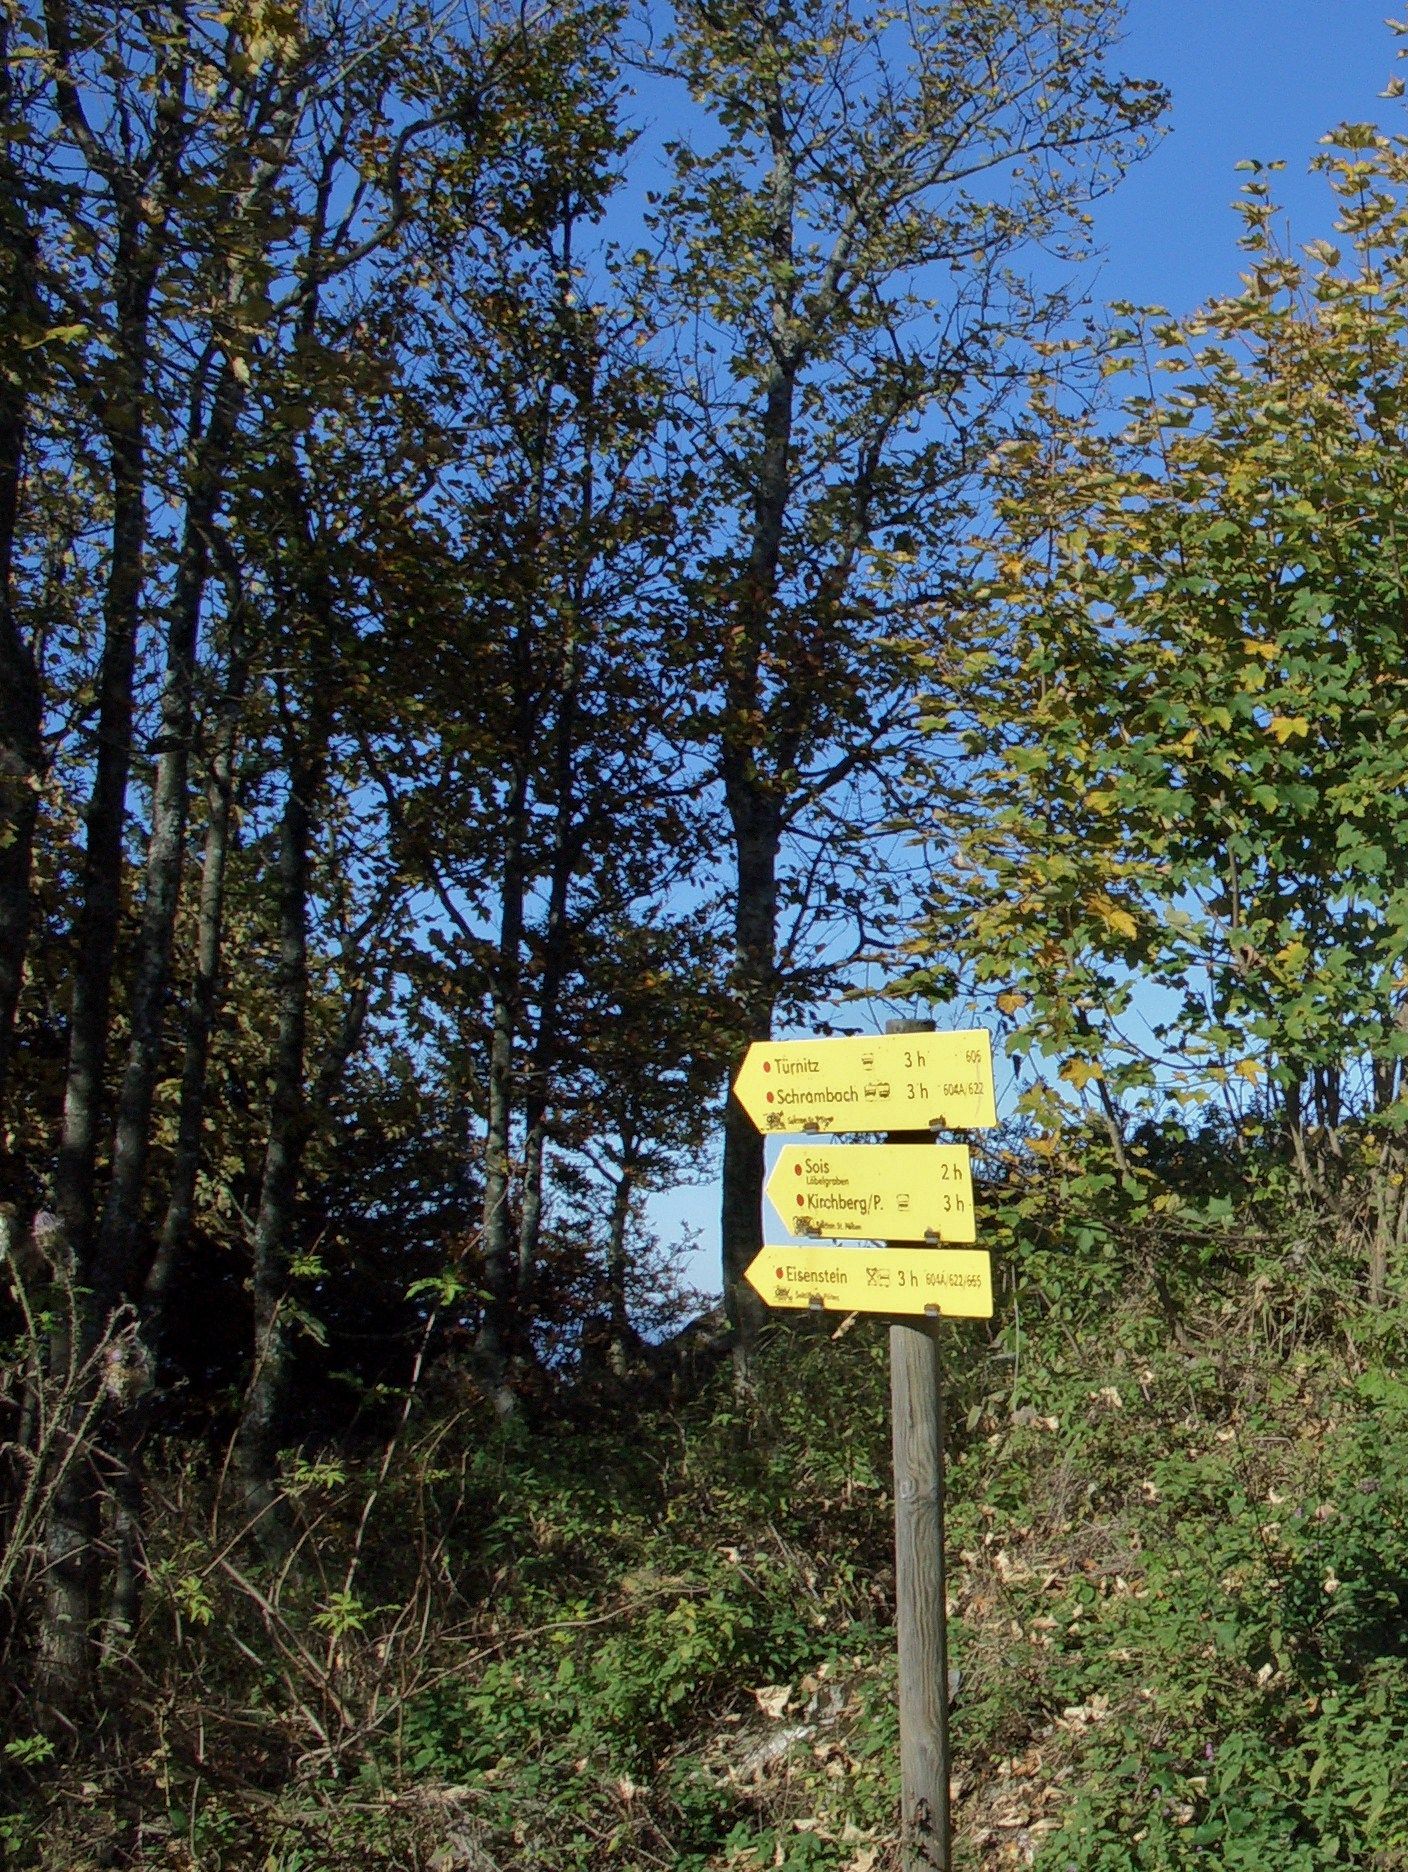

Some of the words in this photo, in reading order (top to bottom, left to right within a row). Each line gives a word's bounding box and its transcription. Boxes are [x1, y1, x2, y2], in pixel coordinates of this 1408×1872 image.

[774, 1057, 820, 1075] Türnitz
[904, 1051, 913, 1068] 3
[917, 1051, 926, 1067] h
[776, 1085, 859, 1105] Schrambach
[907, 1083, 916, 1099] 3
[920, 1083, 929, 1099] h
[805, 1158, 830, 1174] Sois
[941, 1164, 950, 1180] 2
[954, 1164, 963, 1180] h
[807, 1194, 884, 1215] Kirchberg/P.
[943, 1194, 951, 1212] 3
[955, 1194, 965, 1212] h
[786, 1265, 848, 1284] Eisenstein
[897, 1270, 906, 1287] 3
[910, 1270, 919, 1287] h
